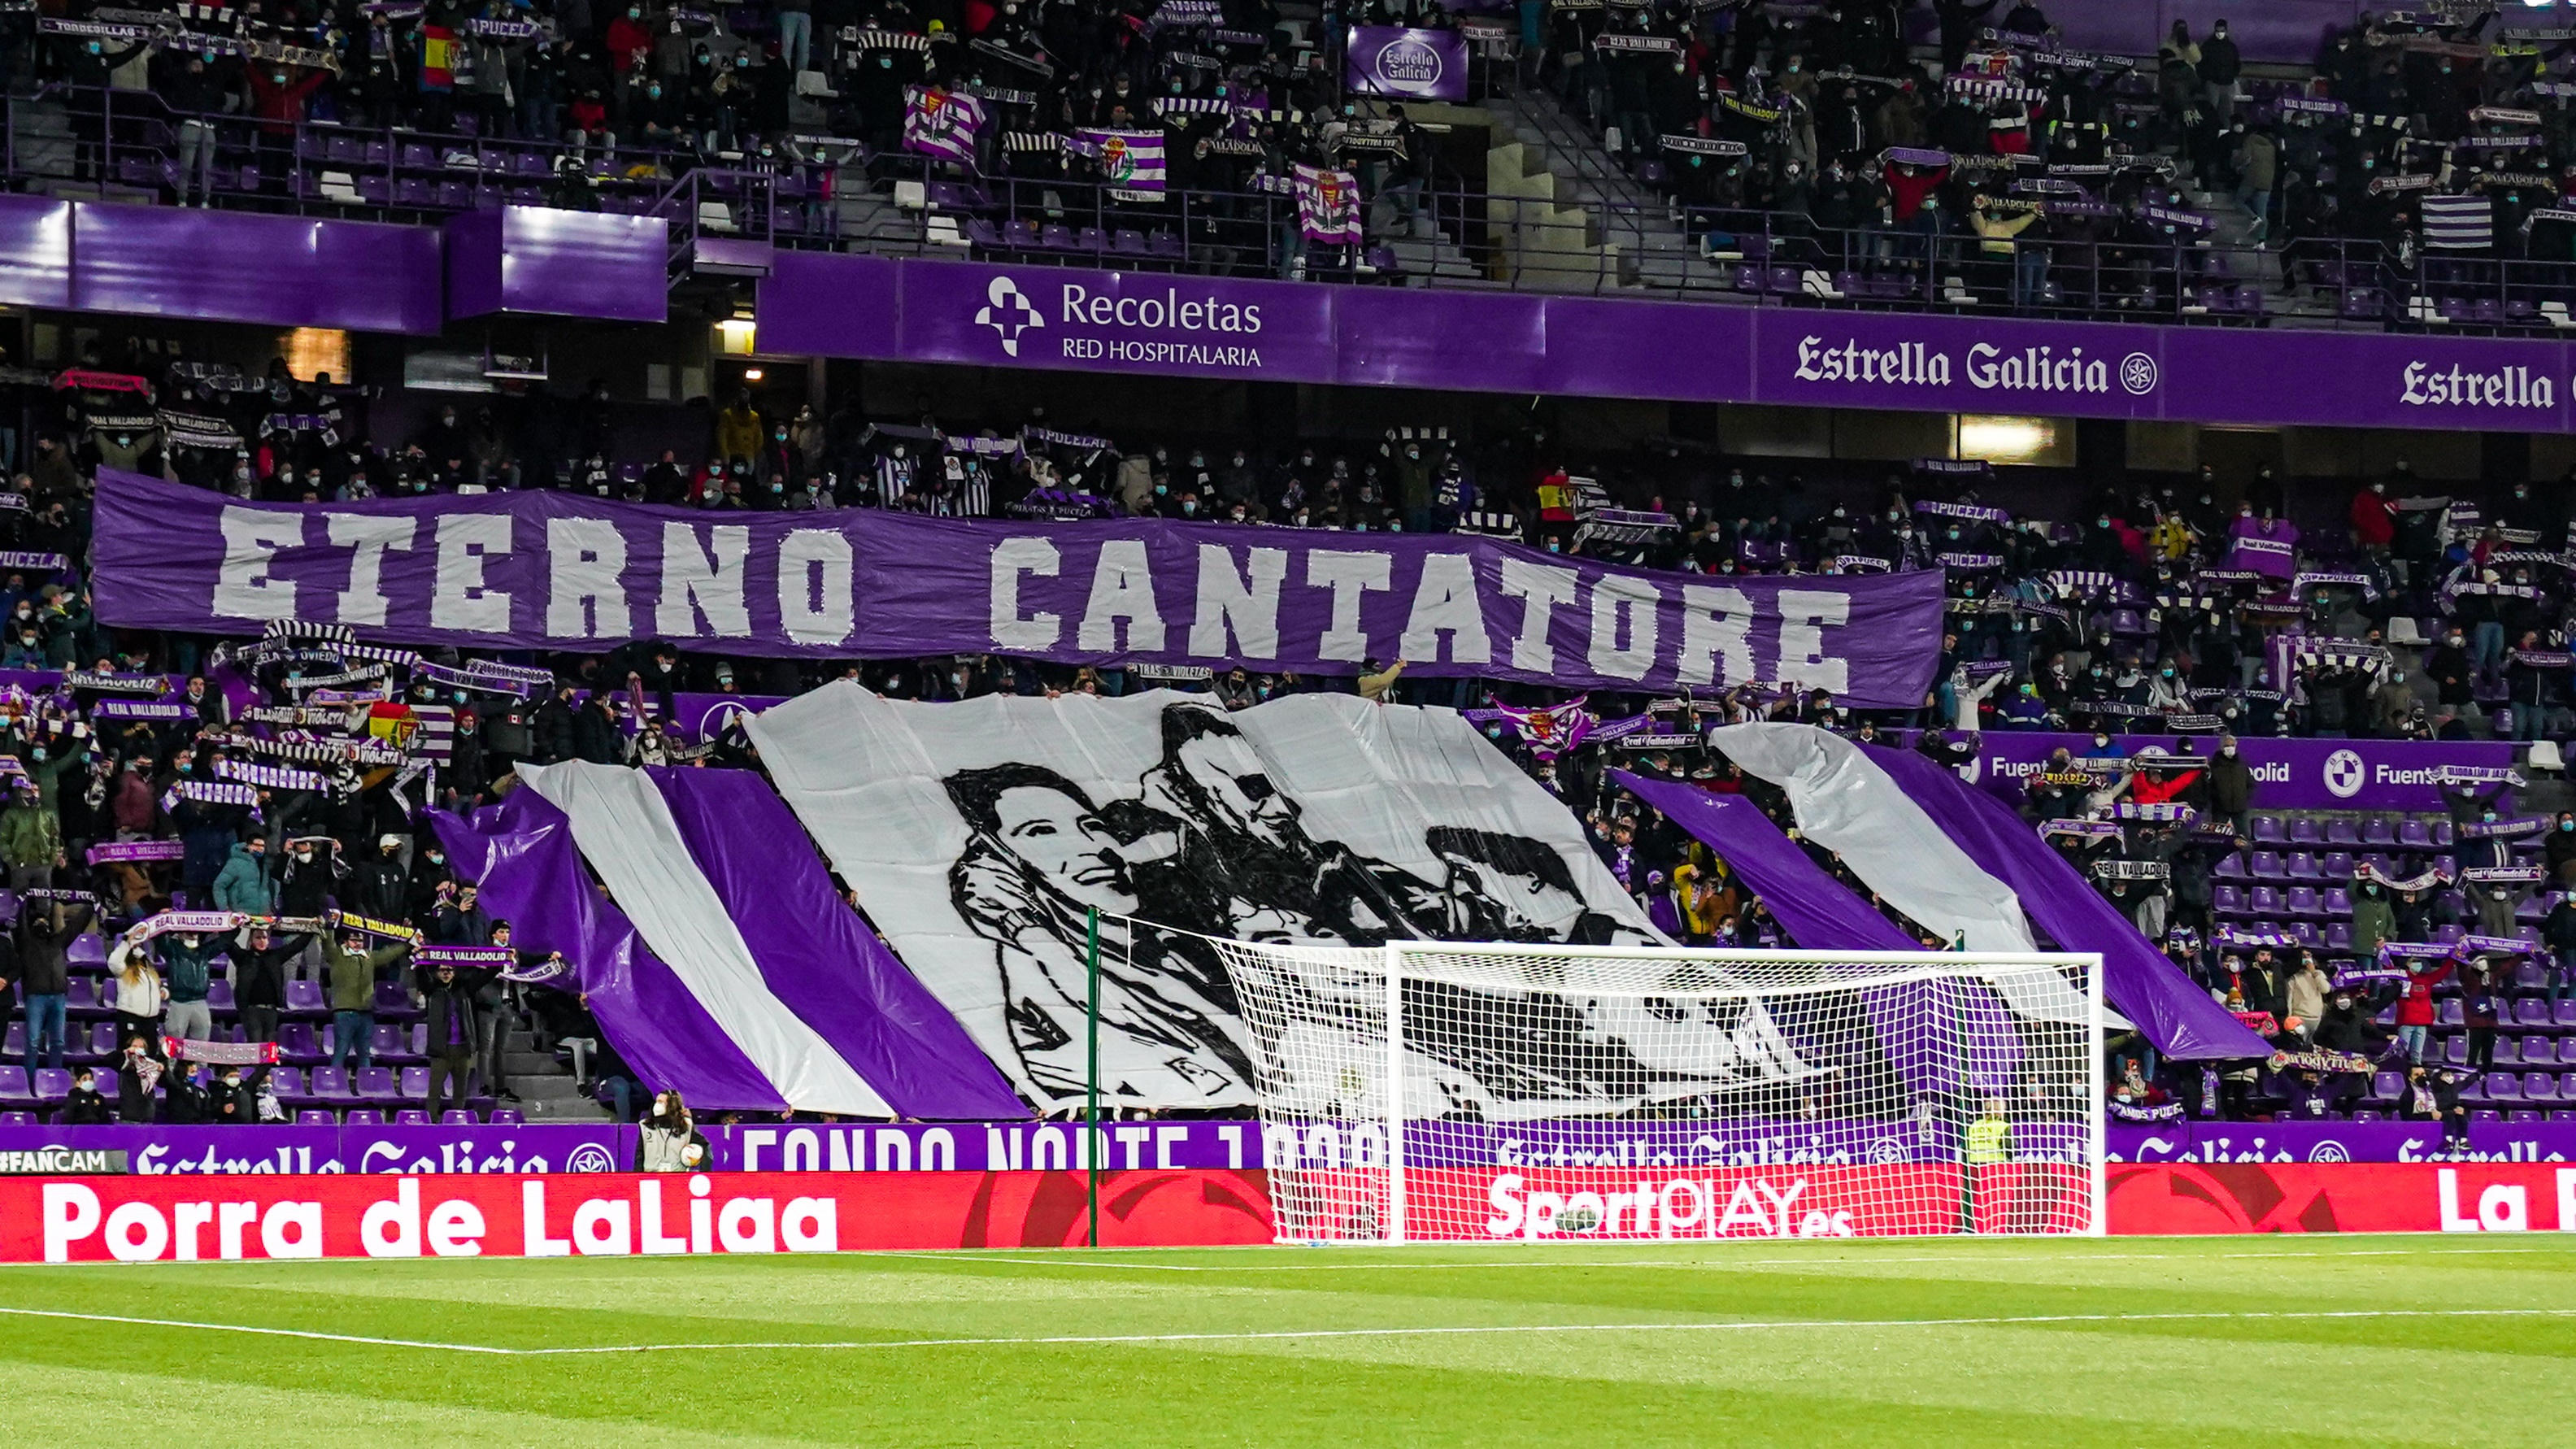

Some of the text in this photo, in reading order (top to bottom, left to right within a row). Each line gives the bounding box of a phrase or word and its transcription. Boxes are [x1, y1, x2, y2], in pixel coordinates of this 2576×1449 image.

[1386, 50, 1434, 67] Estrella
[1388, 64, 1432, 80] Galicia
[1063, 284, 1262, 333] Recoletas
[1063, 337, 1262, 368] RED HOSPITALARIA
[1794, 335, 2108, 394] Estrella Galicia
[2400, 360, 2554, 407] Estrella
[108, 416, 154, 426] VALLADOLID
[1047, 429, 1100, 447] PUCELA
[1939, 503, 1991, 521] PUCELA
[1860, 558, 1887, 568] PUCEL
[2199, 571, 2217, 579] REAL
[211, 504, 1851, 694] ETERNO CANTATORE
[2246, 603, 2301, 613] REAL VALLADOLID
[300, 651, 340, 664] OVIEDO
[1140, 665, 1211, 677] TRAS VIOLETAS
[107, 703, 181, 716] REAL VALLADOLID
[307, 708, 346, 724] VIOLETA
[1621, 734, 1686, 747] Real Valladolid
[360, 749, 400, 766] VIOLETA
[1992, 757, 2051, 777] Fuent
[2248, 762, 2290, 781] olid
[2491, 820, 2536, 834] VALLADOLID
[2097, 862, 2118, 877] REAL
[2484, 868, 2530, 879] Valladolid
[155, 915, 223, 929] REAL VALLADOLID
[342, 914, 415, 938] REAL VALLADOLID
[2409, 944, 2455, 955] VALLADOLID
[2488, 939, 2526, 950] VALLADOLID
[429, 951, 507, 961] REAL VALLADOLID
[2364, 968, 2408, 979] VALLADOLID
[533, 1100, 542, 1112] 3
[2151, 1103, 2182, 1118] PUCE
[743, 1127, 956, 1171] FONDO
[0, 1150, 107, 1172] #FANCAM
[2438, 1168, 2528, 1232] La
[42, 1173, 838, 1262] Porra de LaLiga
